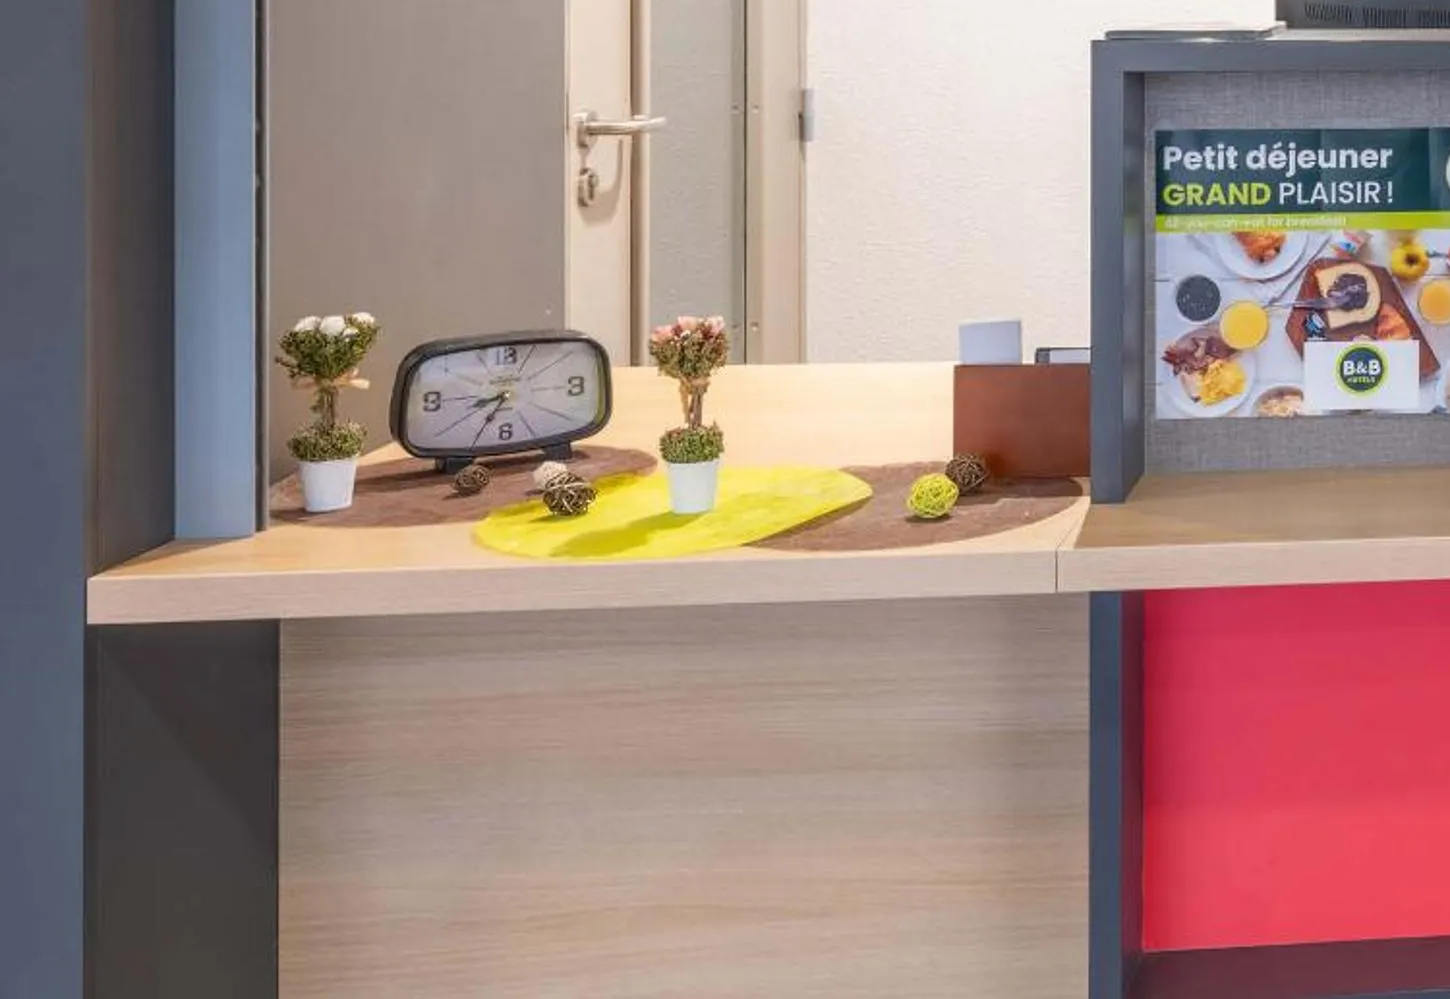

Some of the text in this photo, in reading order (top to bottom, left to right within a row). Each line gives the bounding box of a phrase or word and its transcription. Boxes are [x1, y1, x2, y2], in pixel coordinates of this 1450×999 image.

[1162, 141, 1394, 177] Petit déjeuner
[1161, 182, 1273, 206] GRAND
[496, 346, 518, 366] 12
[1342, 359, 1381, 376] B&B
[567, 376, 585, 397] 3
[422, 391, 442, 412] 9
[499, 422, 513, 441] 6
